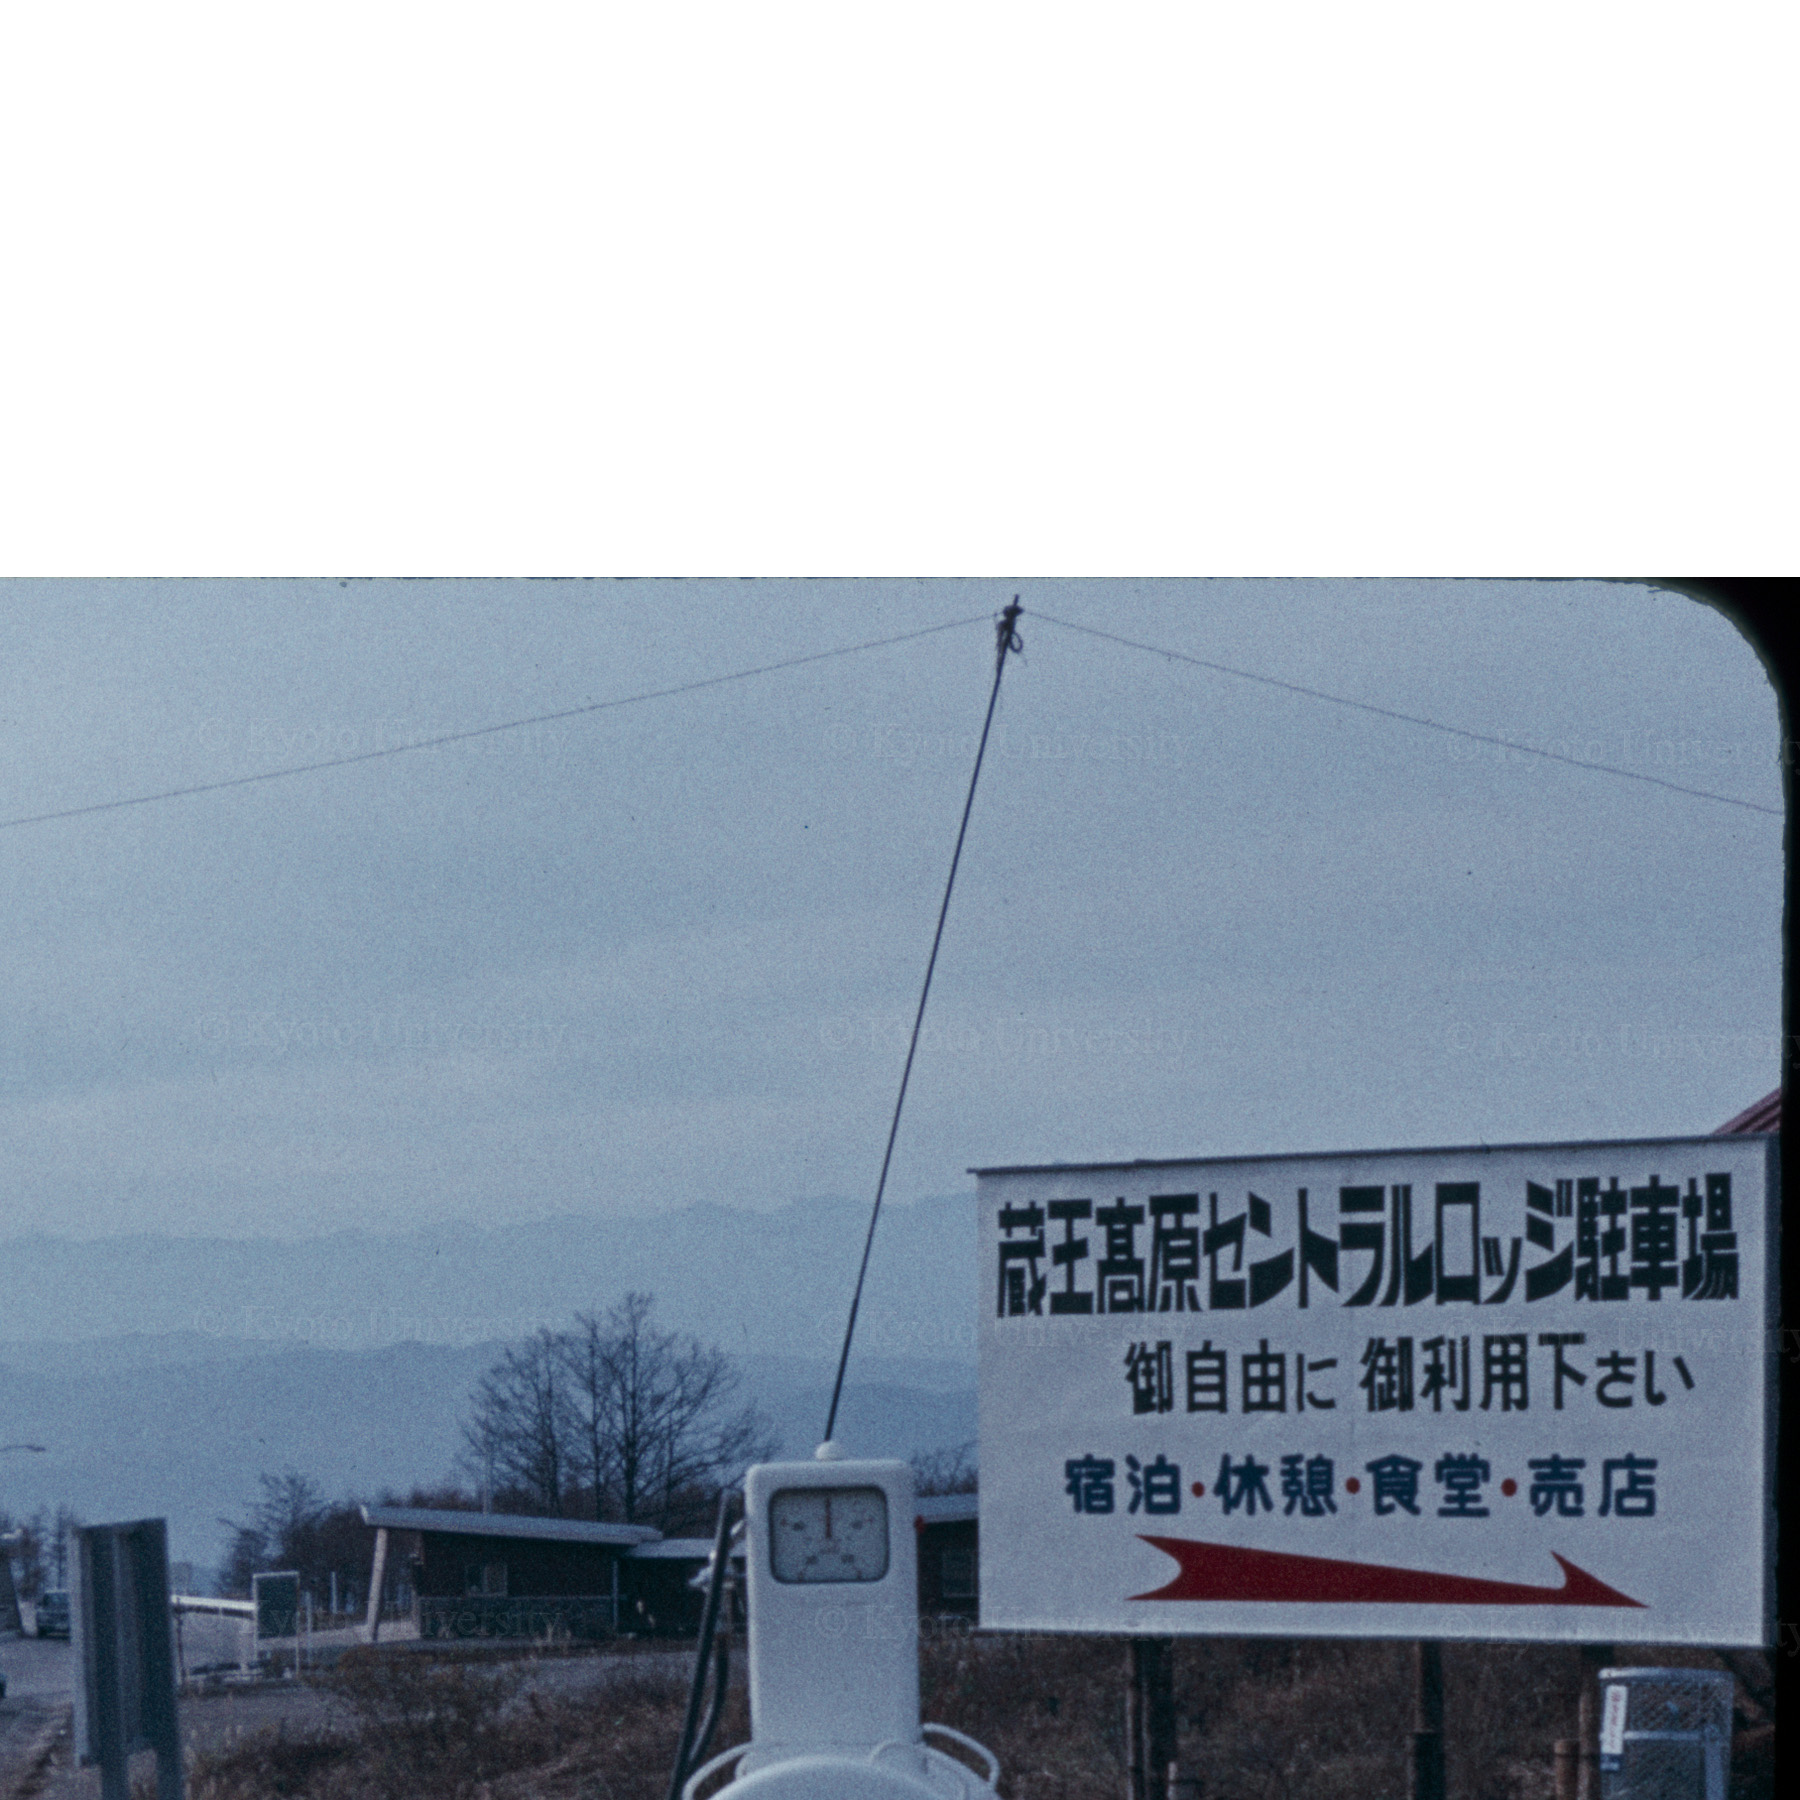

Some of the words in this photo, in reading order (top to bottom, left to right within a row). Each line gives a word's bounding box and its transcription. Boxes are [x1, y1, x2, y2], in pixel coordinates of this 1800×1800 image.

[1124, 1340, 1339, 1415] 御自由に
[1358, 1332, 1696, 1413] 御利用下さい
